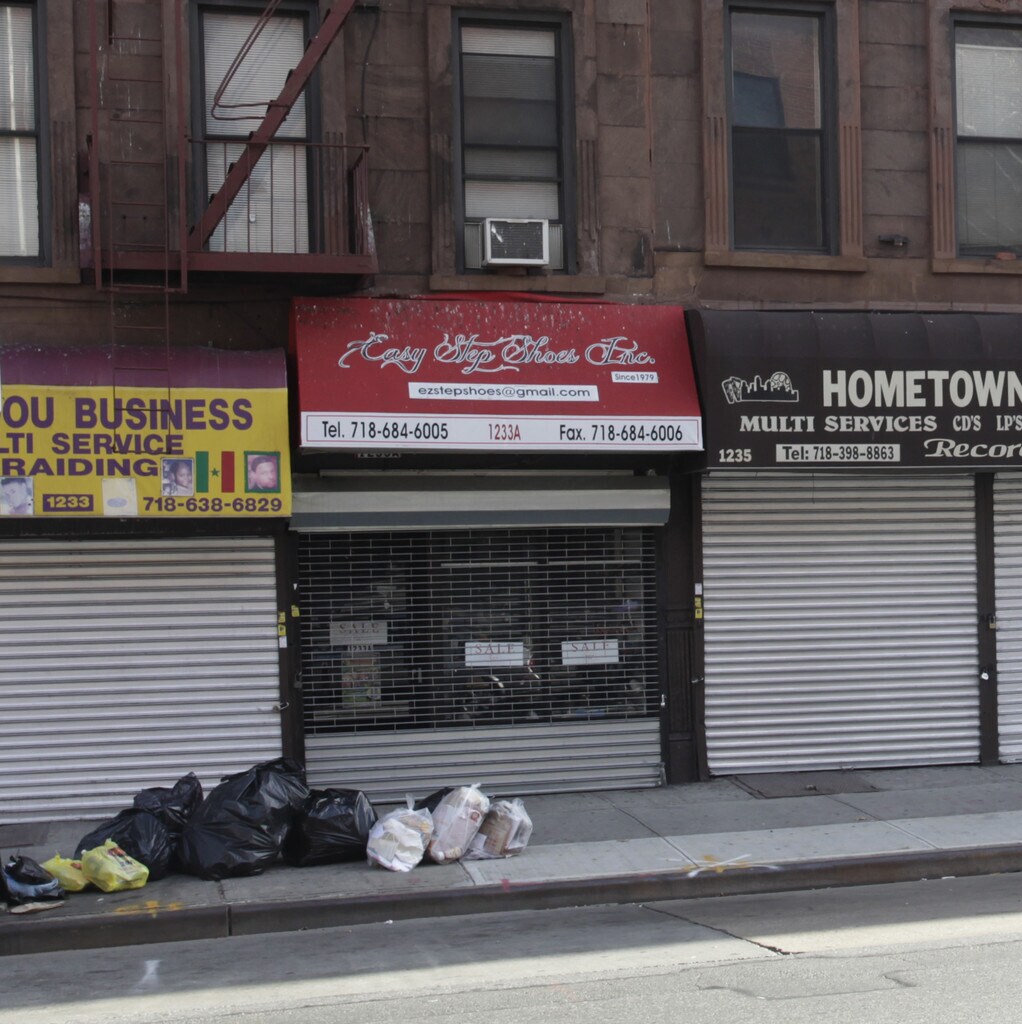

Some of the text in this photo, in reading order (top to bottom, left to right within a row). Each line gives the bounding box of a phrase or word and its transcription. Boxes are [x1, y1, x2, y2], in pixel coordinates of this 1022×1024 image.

[338, 331, 655, 374] Easy Step Shoes Inc.
[418, 385, 591, 399] ezstepshoes@gmail.com
[75, 397, 253, 430] BUSINESS
[322, 421, 449, 439] Tel. 718-684-6005
[489, 423, 521, 440] 1233A
[740, 415, 815, 432] MULTI
[824, 415, 938, 432] SERVICES
[953, 415, 981, 431] CD'S
[996, 415, 1022, 431] LP'S
[560, 425, 683, 441] Fax. 718-684-6006
[52, 433, 184, 455] SERVICE
[719, 449, 752, 463] 1235
[783, 446, 894, 460] Tel: 718-398-8863
[2, 458, 158, 476] RAIDING
[47, 496, 90, 508] 1233
[143, 497, 282, 512] 718-638-6829
[475, 643, 515, 655] SALE
